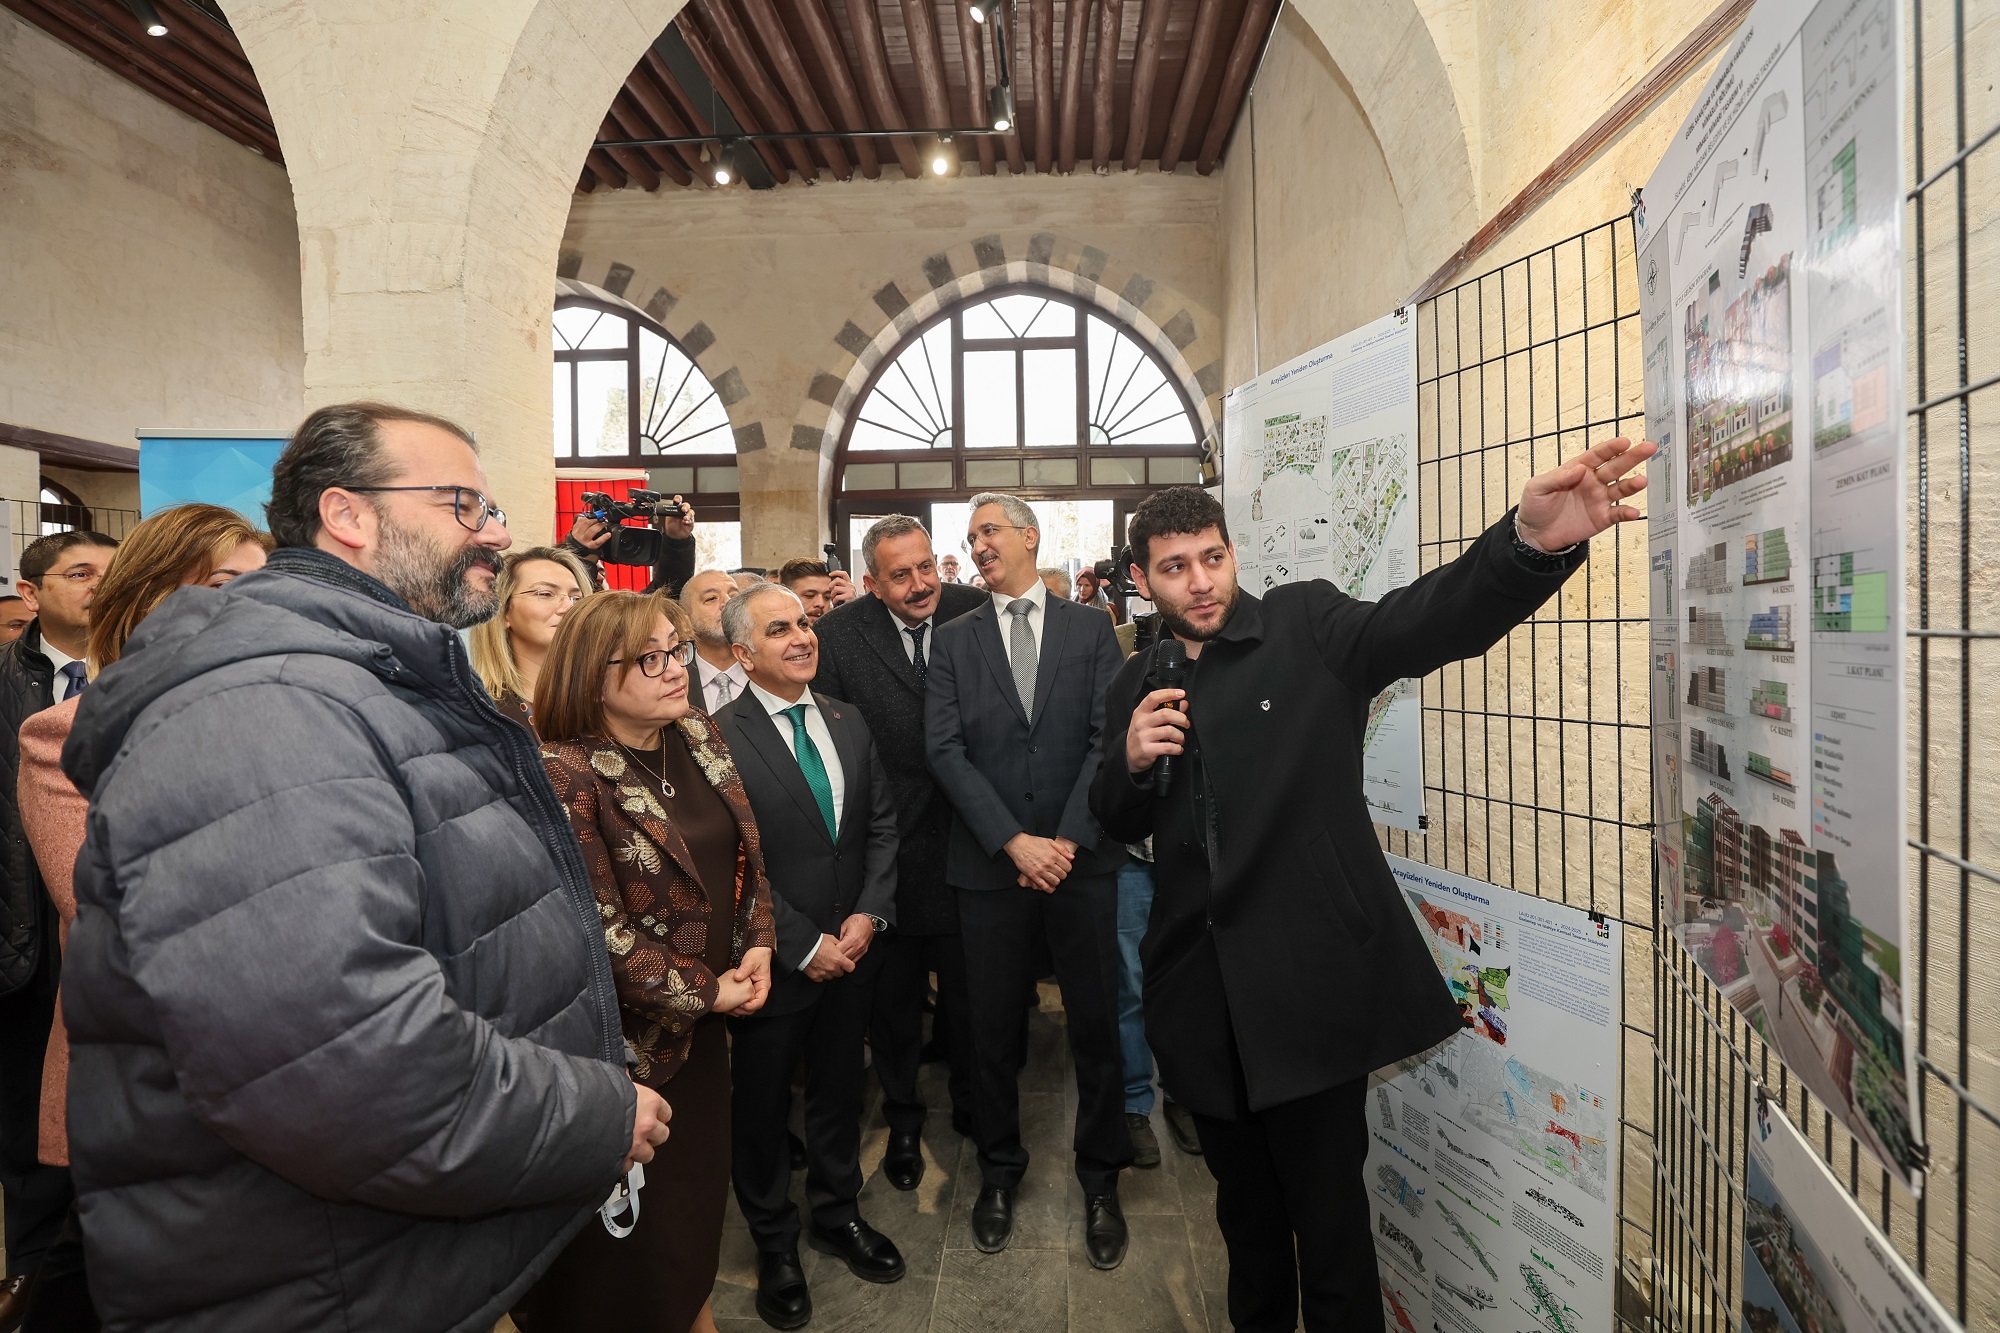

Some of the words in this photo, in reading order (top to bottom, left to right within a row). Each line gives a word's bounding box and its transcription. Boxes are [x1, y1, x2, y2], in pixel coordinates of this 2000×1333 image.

[1271, 371, 1291, 385] Arayüzleri
[1291, 364, 1308, 376] Yeniden
[1308, 353, 1333, 368] Oluşturma
[1392, 867, 1423, 884] Arayüzleri
[1424, 877, 1451, 893] Yeniden
[1452, 886, 1490, 906] Oluşturma
